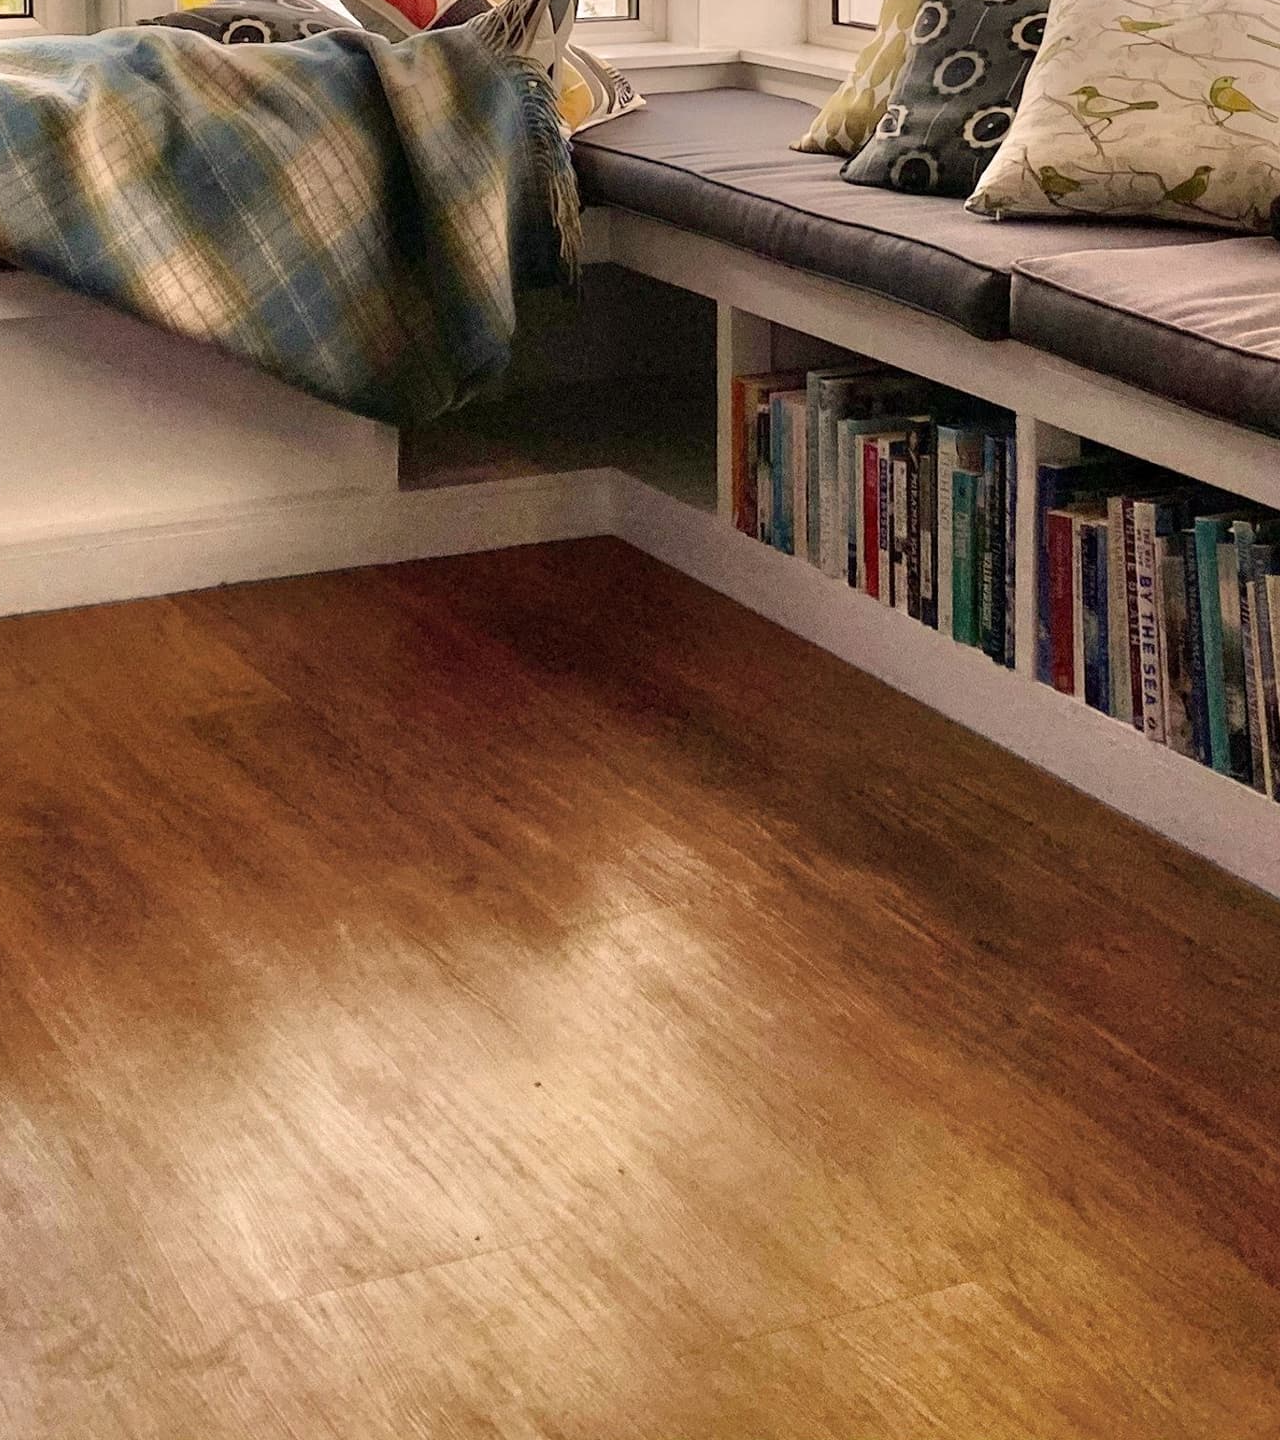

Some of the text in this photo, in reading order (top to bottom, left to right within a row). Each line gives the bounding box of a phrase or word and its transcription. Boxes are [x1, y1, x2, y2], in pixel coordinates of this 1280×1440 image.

[909, 471, 920, 533] MIRANDA
[1125, 506, 1136, 572] WHITE
[1128, 581, 1139, 646] DEATH
[1139, 575, 1157, 706] BY THE SEA
